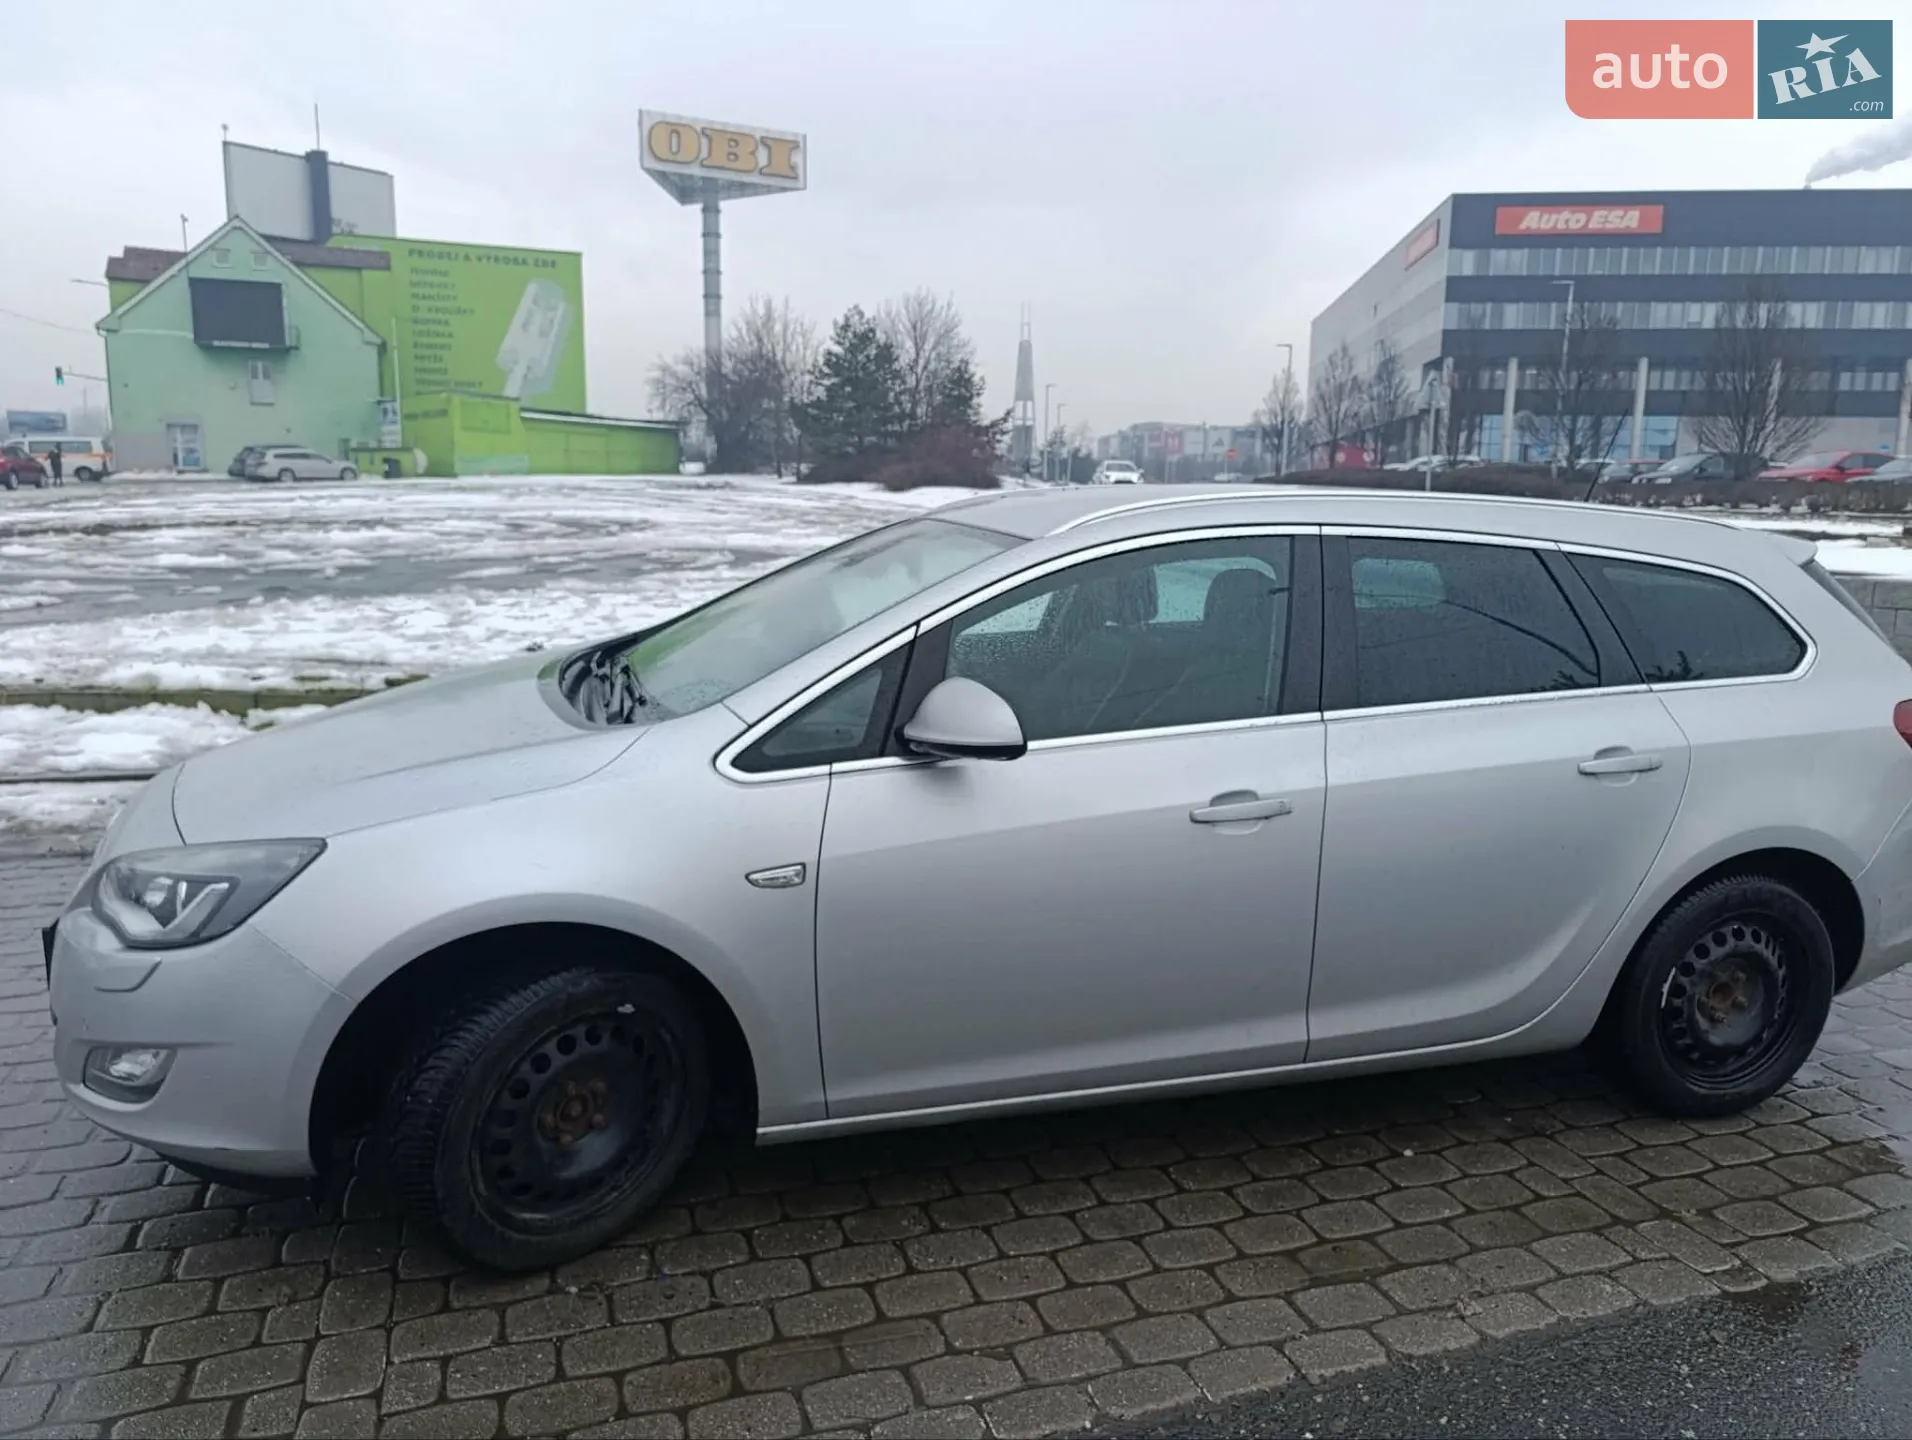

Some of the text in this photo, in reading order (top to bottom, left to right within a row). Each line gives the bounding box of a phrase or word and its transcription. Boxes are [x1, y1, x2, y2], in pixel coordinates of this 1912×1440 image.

[648, 120, 800, 180] OBI
[1518, 209, 1641, 230] Auto ESA
